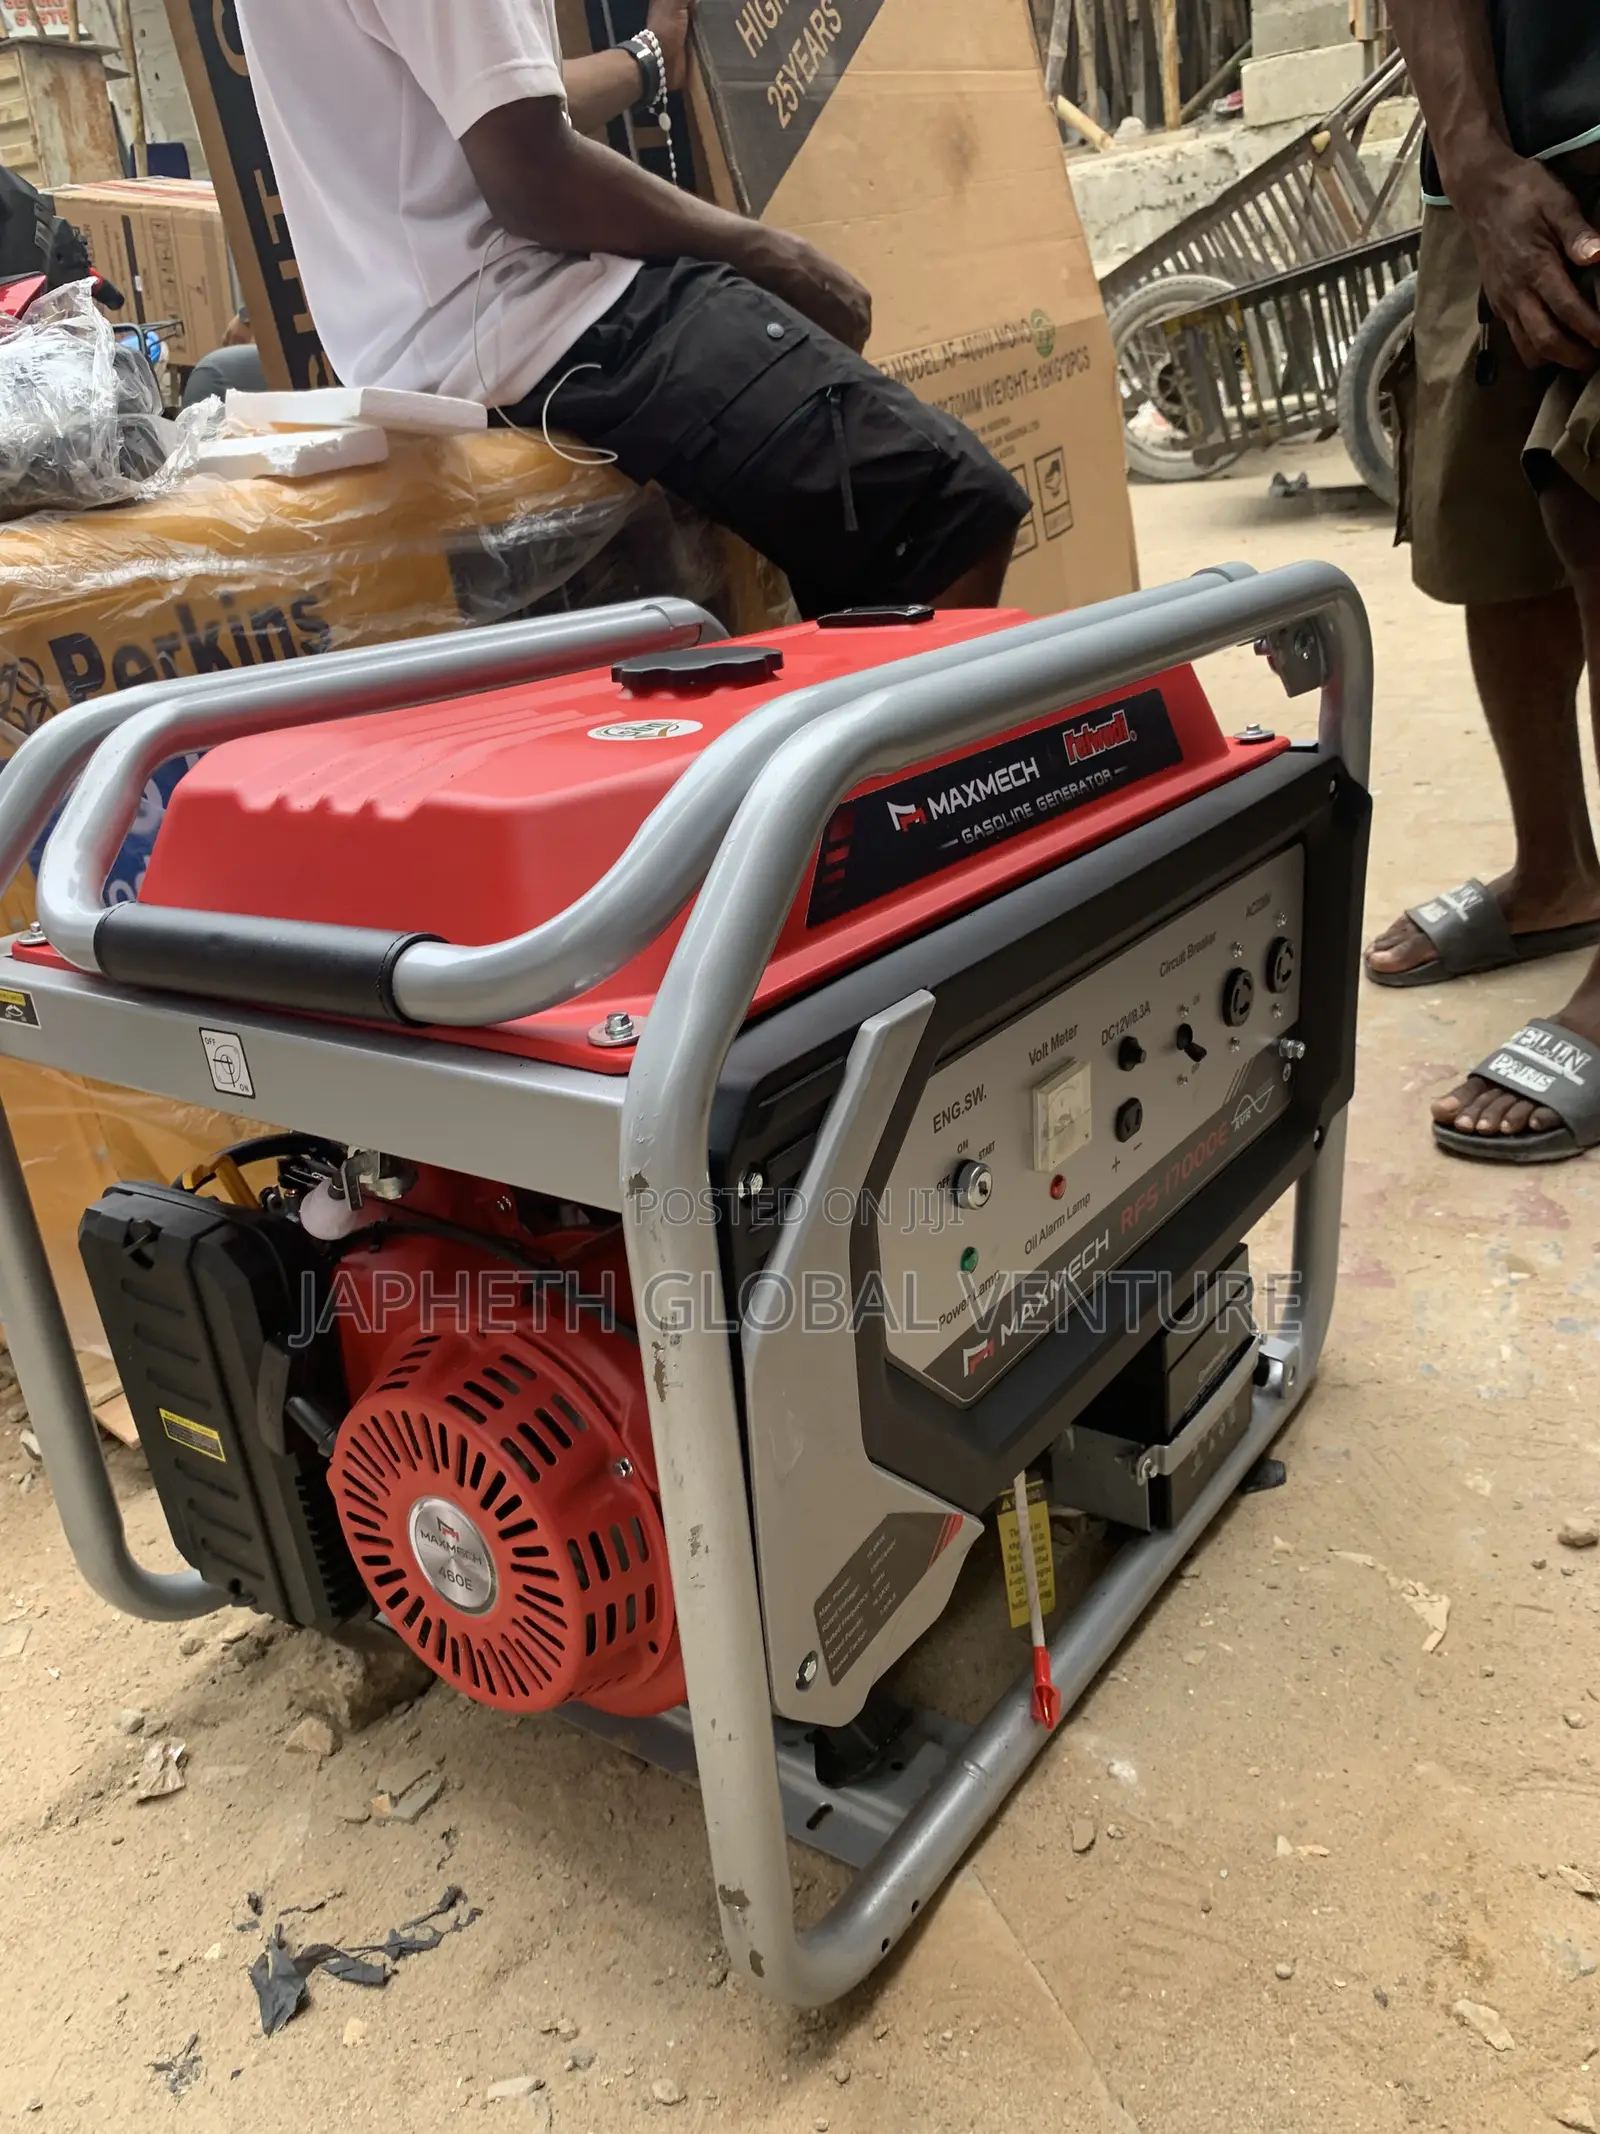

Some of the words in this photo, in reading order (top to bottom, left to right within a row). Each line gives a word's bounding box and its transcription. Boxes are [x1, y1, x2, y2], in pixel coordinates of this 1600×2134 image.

[767, 0, 842, 129] 25YEARS
[48, 592, 333, 706] Perkins
[927, 757, 1041, 821] MAXMECH
[961, 802, 1034, 845] GASOLINE
[1036, 768, 1113, 812] GENERATOR
[204, 1036, 216, 1046] OFF
[1028, 1036, 1049, 1067] Volt
[1050, 1023, 1079, 1053] Meter
[239, 1083, 250, 1093] ON
[933, 1083, 988, 1135] ENG.SW.
[957, 1138, 969, 1154] ON
[978, 1141, 996, 1161] START
[936, 1175, 951, 1192] OFF
[1024, 1234, 1038, 1256] Oil
[1038, 1210, 1066, 1247] Alarm
[1066, 1193, 1091, 1221] Lamp
[1001, 1228, 1109, 1347] MAXMECH
[420, 1530, 483, 1566] MAXMECH
[438, 1566, 474, 1592] 460E
